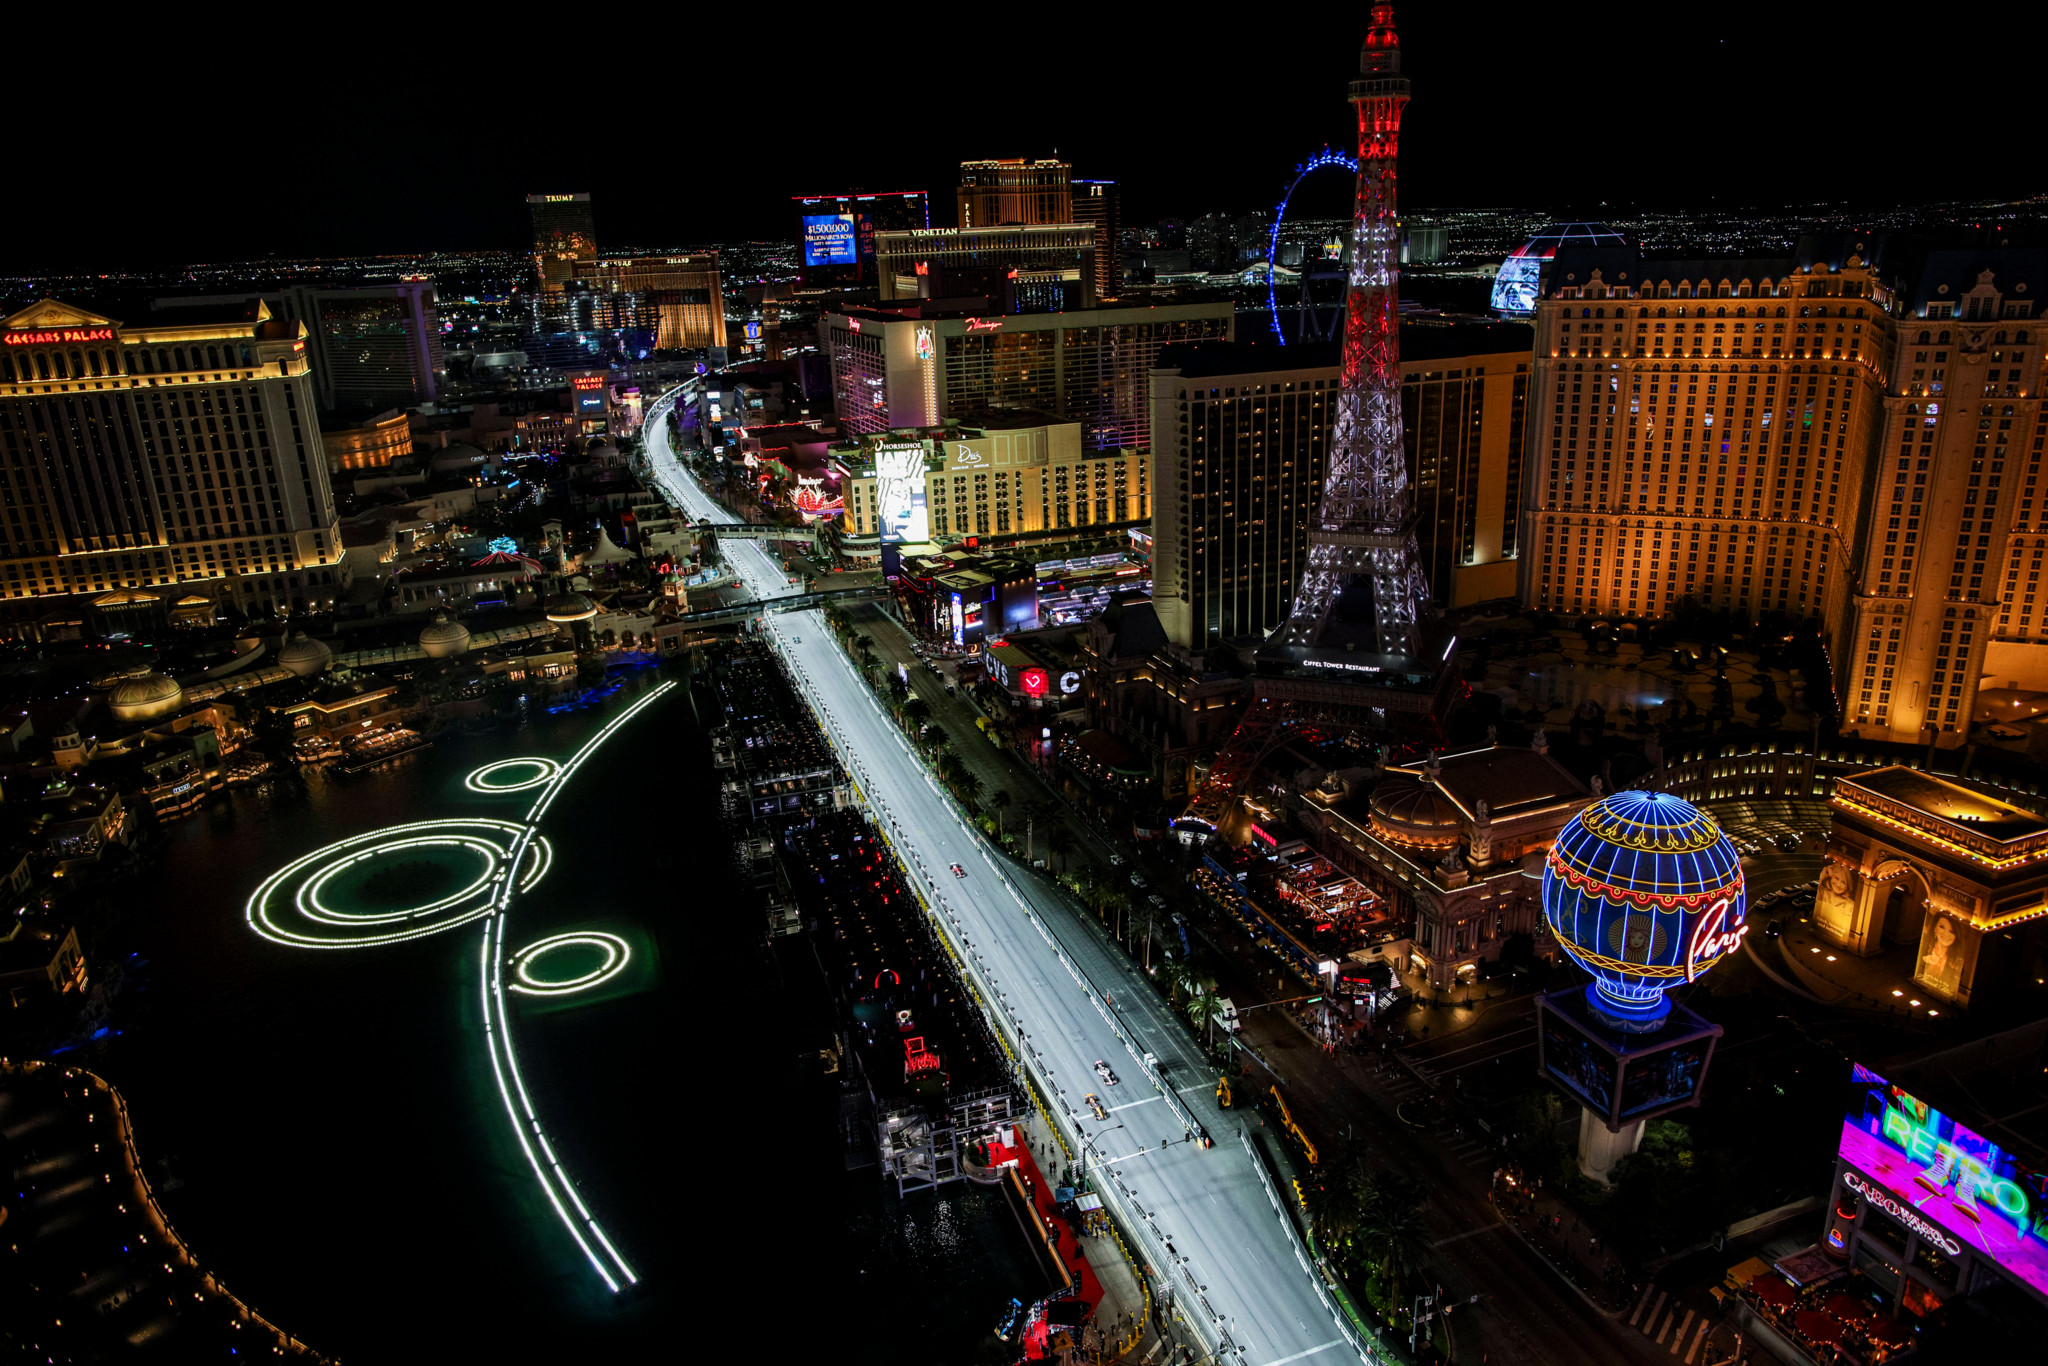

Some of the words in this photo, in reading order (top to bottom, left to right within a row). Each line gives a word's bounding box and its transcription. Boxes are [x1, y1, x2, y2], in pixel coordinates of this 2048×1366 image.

[545, 194, 574, 203] TRUMP
[911, 228, 959, 237] VENETIAN
[666, 257, 690, 265] ISLAND
[4, 332, 60, 345] CAESARS
[63, 329, 113, 342] PALACE
[574, 376, 604, 384] CAESARS
[883, 442, 923, 451] HORSESHOE
[985, 652, 1009, 687] CVS
[1687, 898, 1749, 984] Paris
[1886, 1110, 2026, 1213] RETRO
[1843, 1171, 1900, 1217] CABO
[1899, 1206, 1961, 1255] WABO
